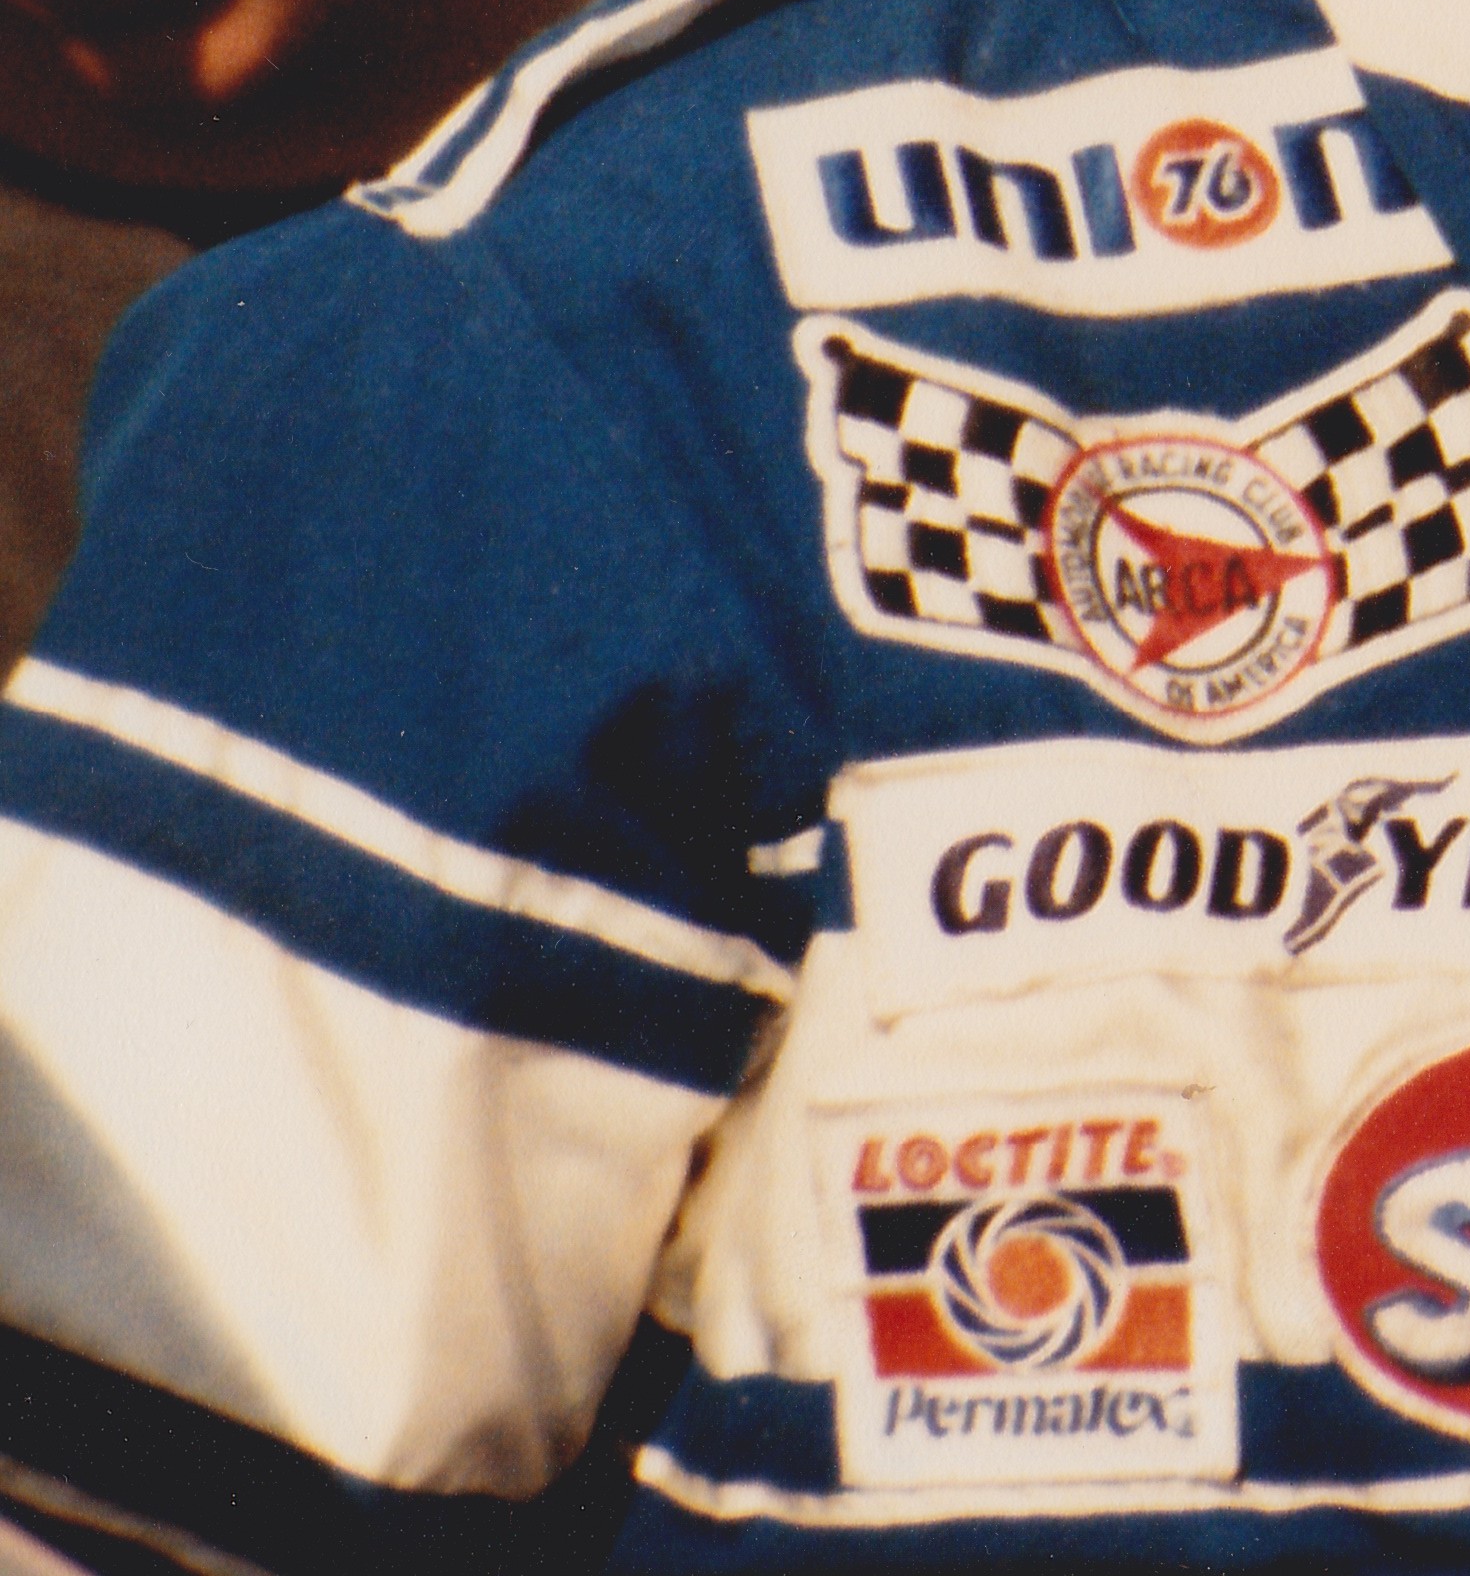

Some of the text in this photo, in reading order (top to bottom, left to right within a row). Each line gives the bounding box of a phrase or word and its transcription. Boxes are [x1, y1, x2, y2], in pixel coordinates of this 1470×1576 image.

[1153, 145, 1257, 221] 76
[1117, 451, 1236, 484] RACING
[1241, 476, 1303, 546] CLUB
[1114, 553, 1260, 619] ARCA
[930, 817, 1293, 937] GOOD
[852, 1117, 1161, 1193] LOCTITE
[883, 1384, 1189, 1439] Permatex
